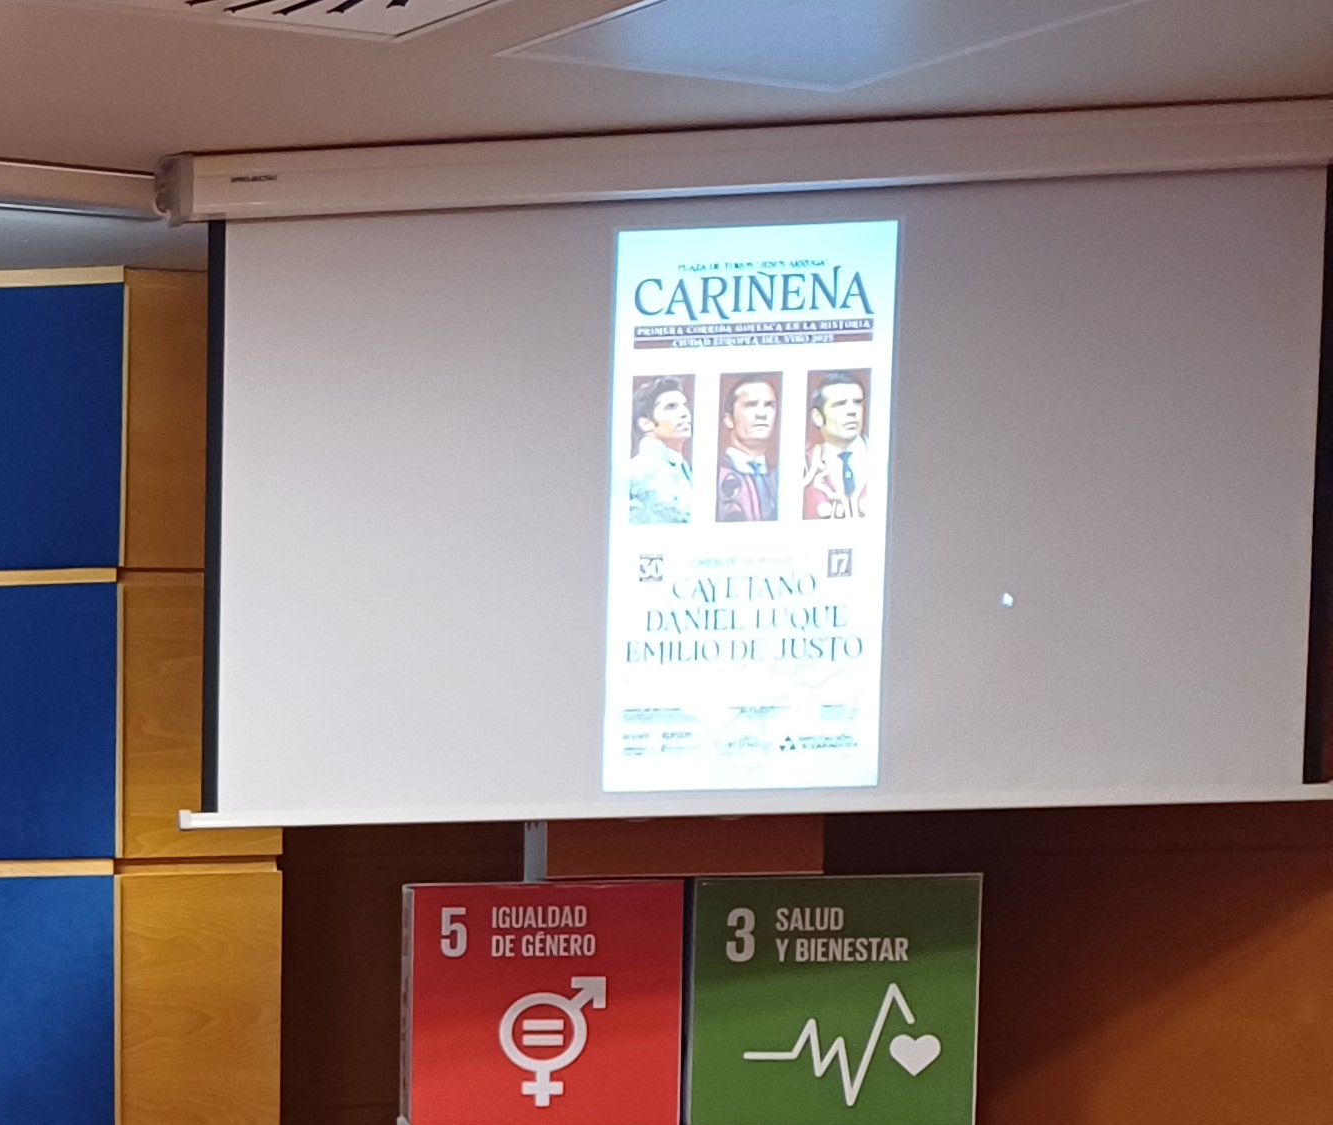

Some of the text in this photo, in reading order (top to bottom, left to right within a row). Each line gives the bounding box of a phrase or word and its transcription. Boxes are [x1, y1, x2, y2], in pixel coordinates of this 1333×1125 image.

[634, 265, 875, 321] CARIÑENA
[640, 557, 664, 580] 30
[671, 571, 817, 603] CAYETANO
[646, 605, 849, 635] DANIEL LUQUE
[626, 635, 864, 665] EMILIO DE JUSTO
[490, 904, 588, 929] IGUALDAD
[774, 907, 845, 933] SALUD
[439, 906, 468, 958] 5
[490, 929, 596, 958] DE GÉNERO
[725, 907, 757, 963] 3
[775, 937, 910, 963] Y BIENESTAR
